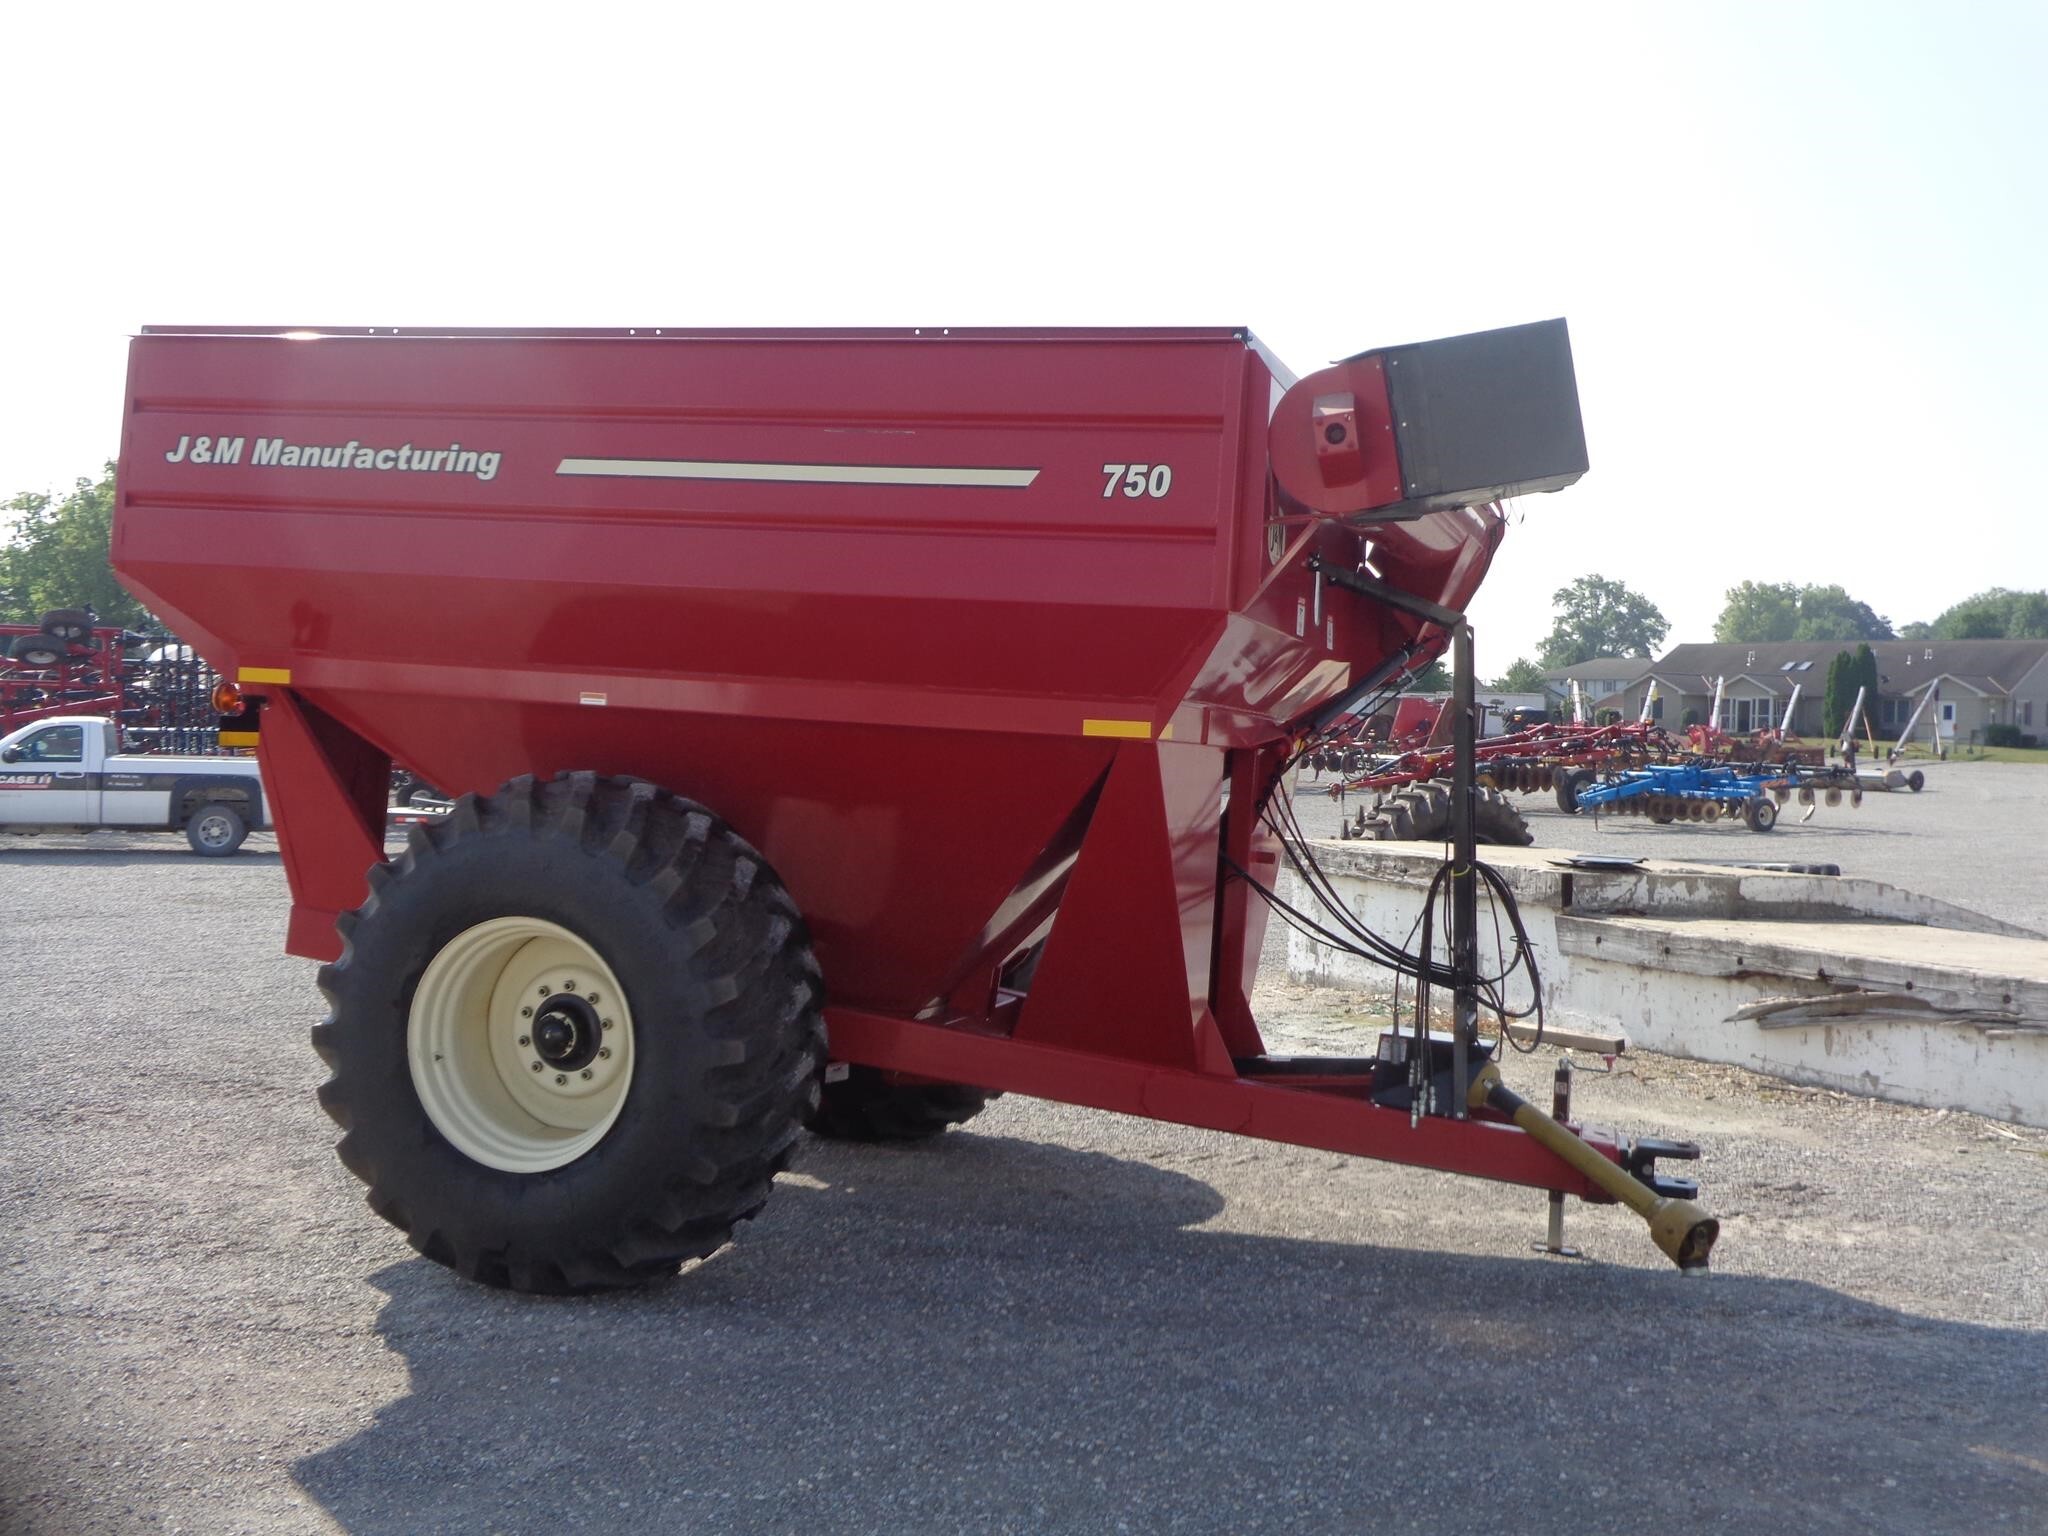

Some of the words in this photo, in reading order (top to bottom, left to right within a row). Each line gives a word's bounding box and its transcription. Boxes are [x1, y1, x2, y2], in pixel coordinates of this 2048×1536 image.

[166, 436, 245, 464] J&M
[251, 438, 501, 480] Manufacturing
[1103, 464, 1172, 498] 750
